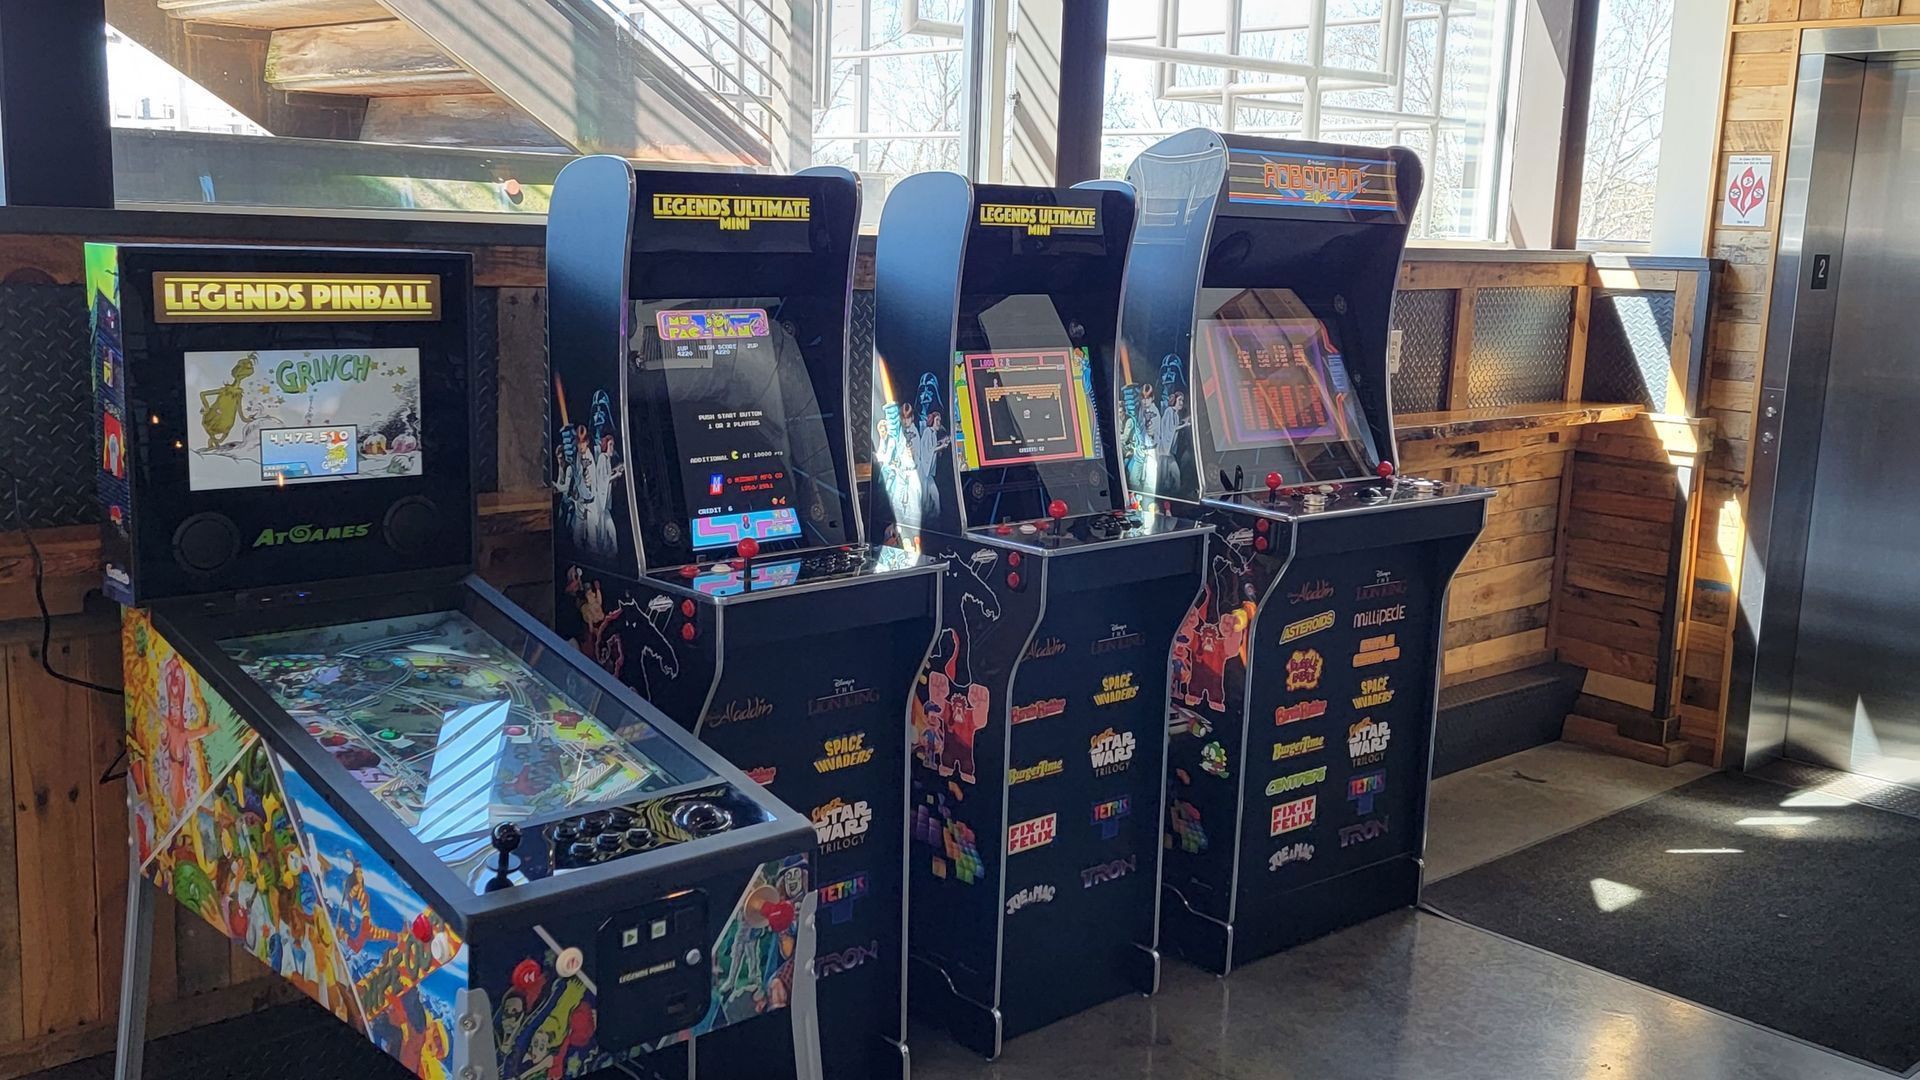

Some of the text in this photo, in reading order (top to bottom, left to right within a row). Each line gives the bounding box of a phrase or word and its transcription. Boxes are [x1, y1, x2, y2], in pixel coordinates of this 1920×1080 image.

[653, 197, 810, 218] LEGENDS ULTIMATE
[980, 207, 1096, 225] LEGENDS ULTIMATE
[720, 217, 750, 230] MINI
[1028, 224, 1050, 236] MINI
[1818, 259, 1826, 278] 2
[165, 283, 432, 311] LEGENDS PINBALL
[669, 325, 752, 339] PAC-MAN
[276, 354, 372, 394] GRINCH
[698, 413, 715, 421] PUSH
[717, 412, 737, 420] START
[733, 420, 761, 428] PLAYERS
[690, 455, 729, 464] ADDITIONAL
[698, 506, 722, 515] CREDIT
[1280, 611, 1335, 644] ASTEROIDS
[1102, 672, 1133, 692] SPACE
[1361, 676, 1390, 695] SPACE
[1093, 686, 1140, 706] INVADERS
[1352, 690, 1395, 710] INVADERS
[709, 697, 774, 728] Aladdin
[1090, 732, 1135, 754] STAR
[1349, 722, 1391, 743] STAR
[824, 732, 865, 757] SPACE
[1349, 734, 1391, 758] WARS
[813, 748, 874, 774] INVADERS
[1091, 744, 1136, 768] WARS
[1352, 752, 1385, 768] TRILOGY
[1095, 762, 1130, 778] TRILOGY
[1351, 775, 1384, 796] TETRIS
[815, 801, 872, 827] STAR
[1094, 799, 1129, 821] TETRIS
[1273, 799, 1314, 821] FIX-IT
[816, 812, 872, 845] WARS
[1010, 817, 1054, 840] FIX-IT
[1272, 812, 1313, 833] FELIX
[1339, 815, 1390, 848] TRON
[819, 834, 866, 855] TRILOGY
[1010, 829, 1053, 851] FELIX
[1269, 845, 1289, 872] JOE
[1294, 843, 1315, 861] MAC
[1081, 854, 1137, 888] TRON
[820, 877, 865, 903] TETRIS
[1007, 888, 1028, 914] JOE
[1033, 884, 1056, 902] MAC
[816, 940, 878, 980] TRON
[618, 959, 676, 984] LEGENDS PINBALL
